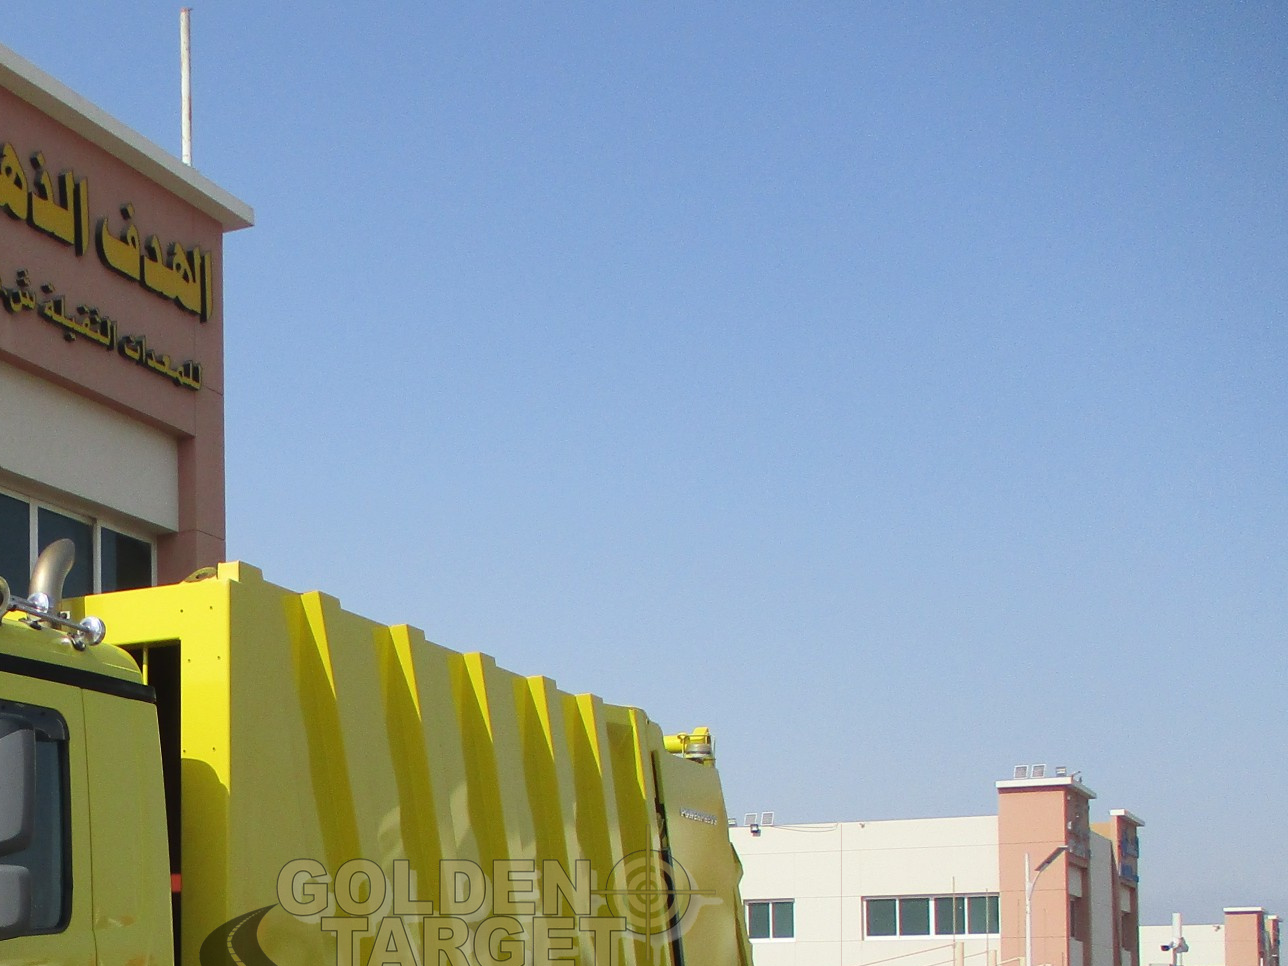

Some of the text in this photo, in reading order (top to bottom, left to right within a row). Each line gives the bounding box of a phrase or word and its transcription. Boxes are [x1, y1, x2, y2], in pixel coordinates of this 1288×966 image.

[95, 202, 212, 323] الهدف
[37, 282, 117, 351] الثقيلة
[117, 334, 202, 390] للمعدات
